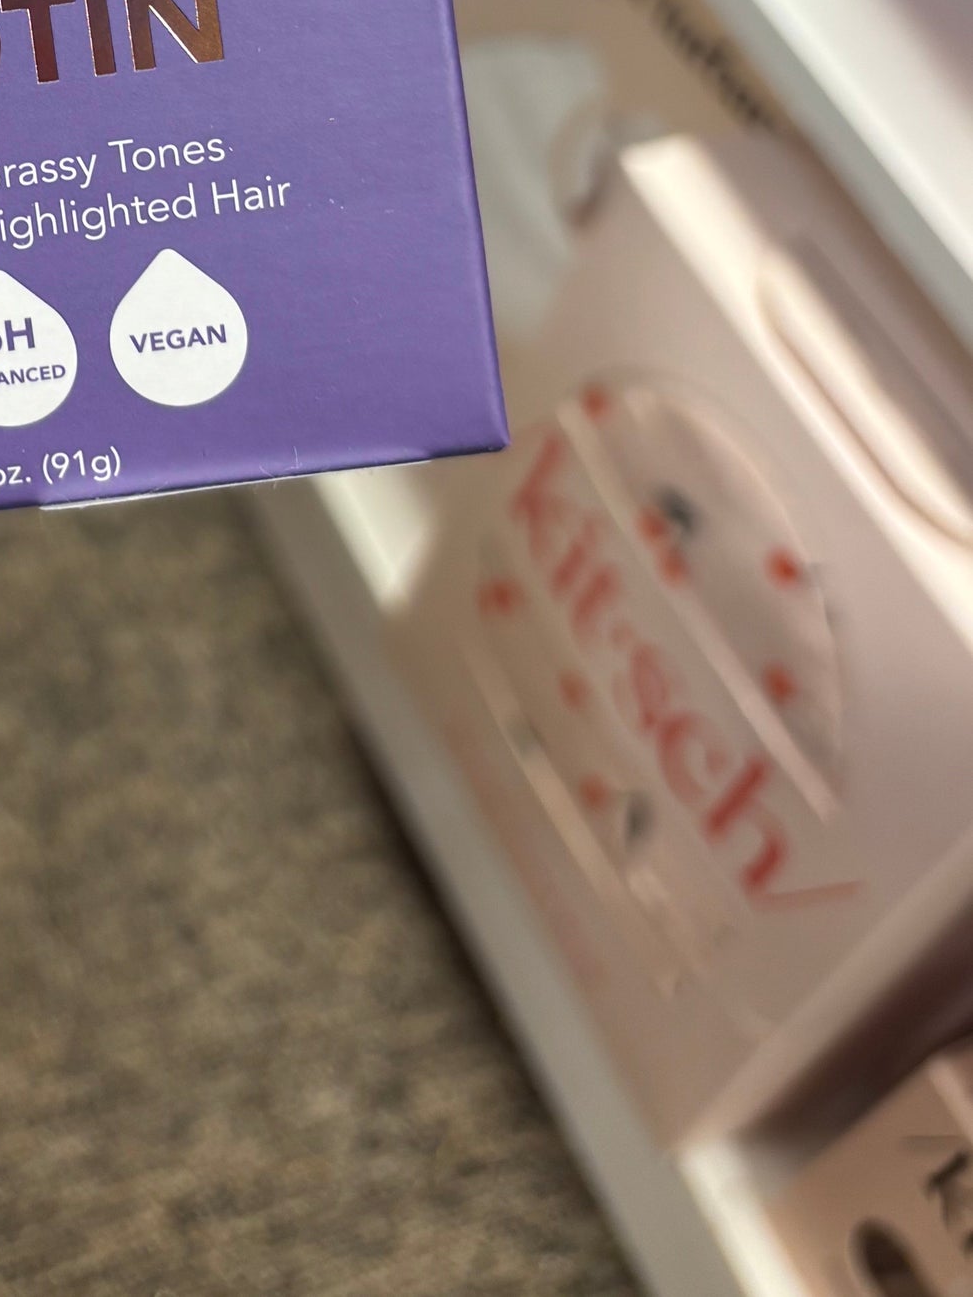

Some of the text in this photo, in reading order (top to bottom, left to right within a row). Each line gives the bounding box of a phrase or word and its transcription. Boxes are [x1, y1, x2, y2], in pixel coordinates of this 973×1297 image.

[108, 138, 226, 175] Tones
[211, 178, 291, 216] Hair
[129, 323, 228, 354] VEGAN
[42, 445, 121, 486] (91g)
